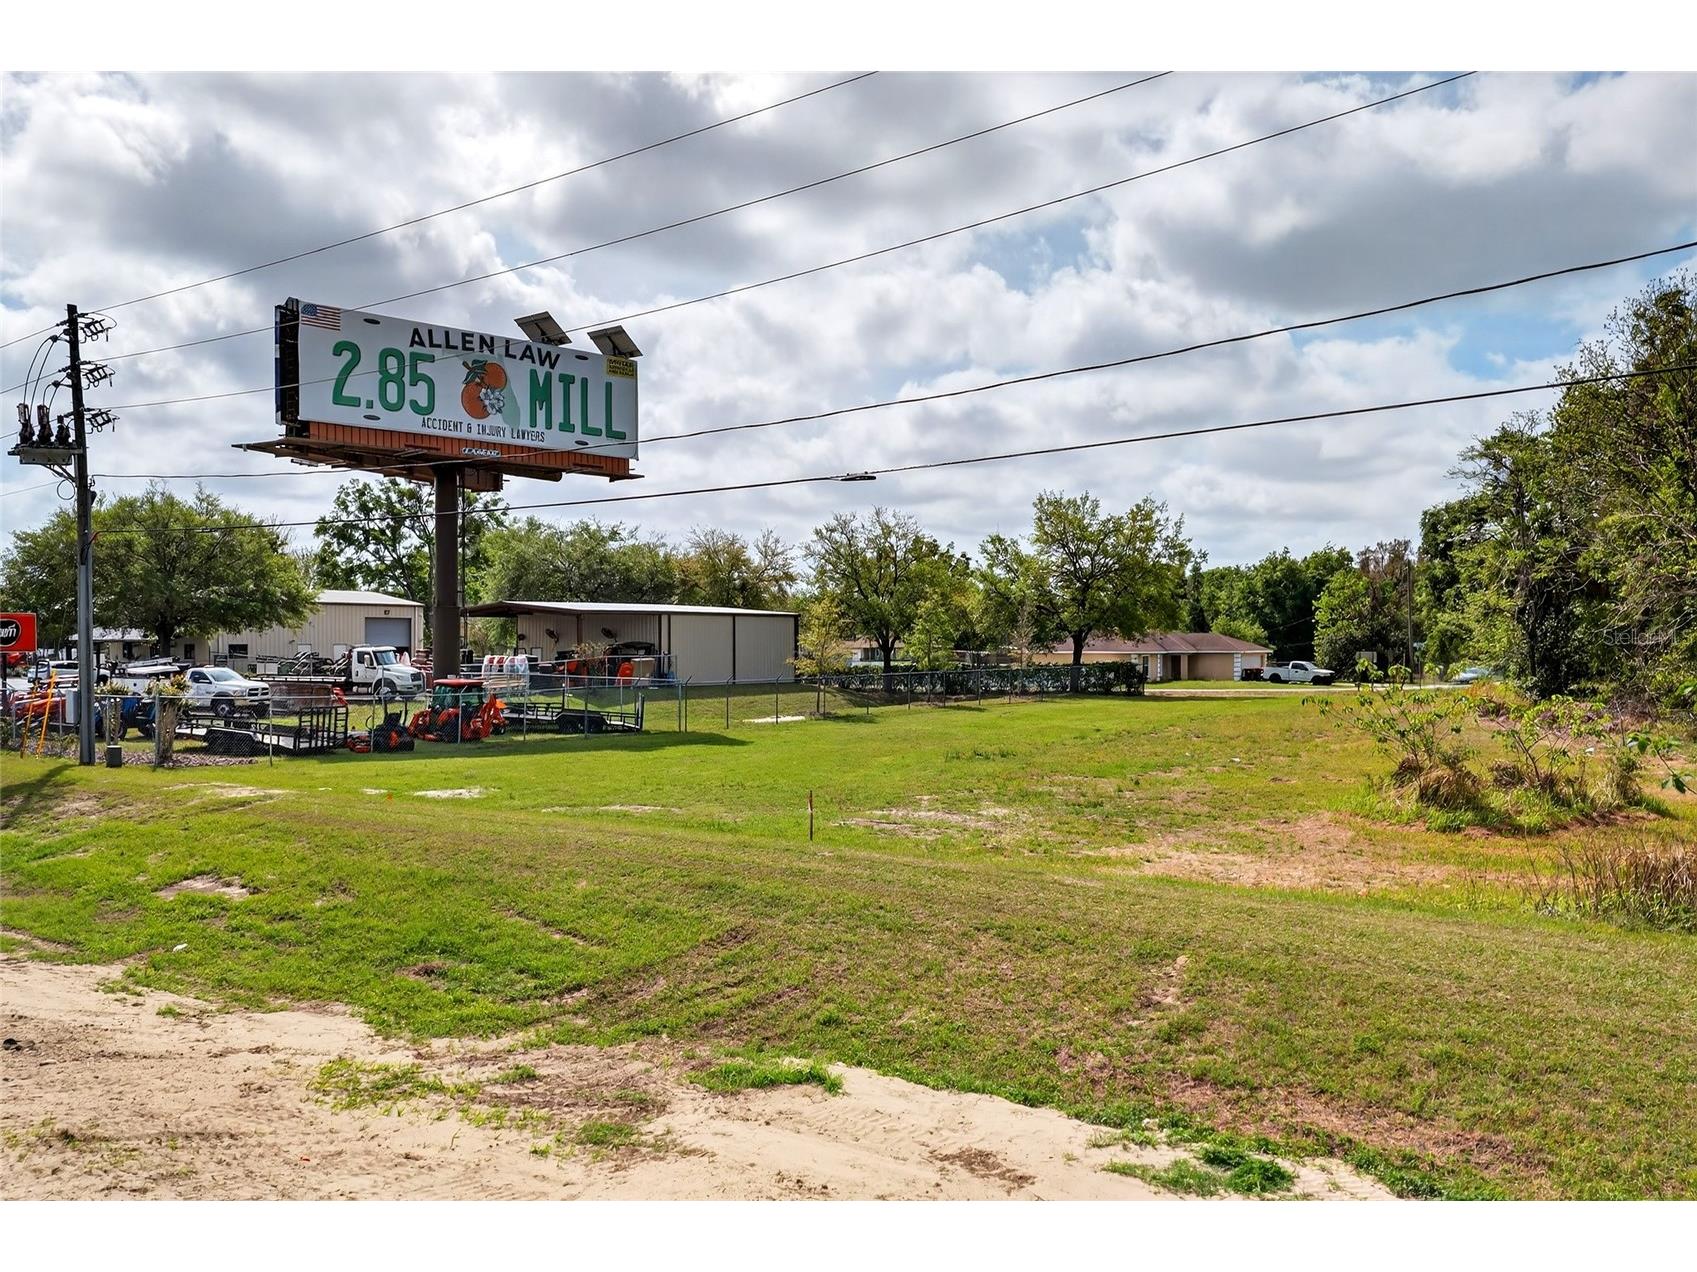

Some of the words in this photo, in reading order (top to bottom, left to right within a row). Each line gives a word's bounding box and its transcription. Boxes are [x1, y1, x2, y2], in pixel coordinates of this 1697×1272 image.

[409, 327, 495, 355] ALLEN
[504, 339, 561, 371] LAW
[332, 341, 435, 415] 2.85
[529, 368, 627, 441] MILL
[421, 417, 463, 432] ACCIDENT
[477, 424, 506, 438] INJURY
[510, 428, 545, 443] LAWYERS
